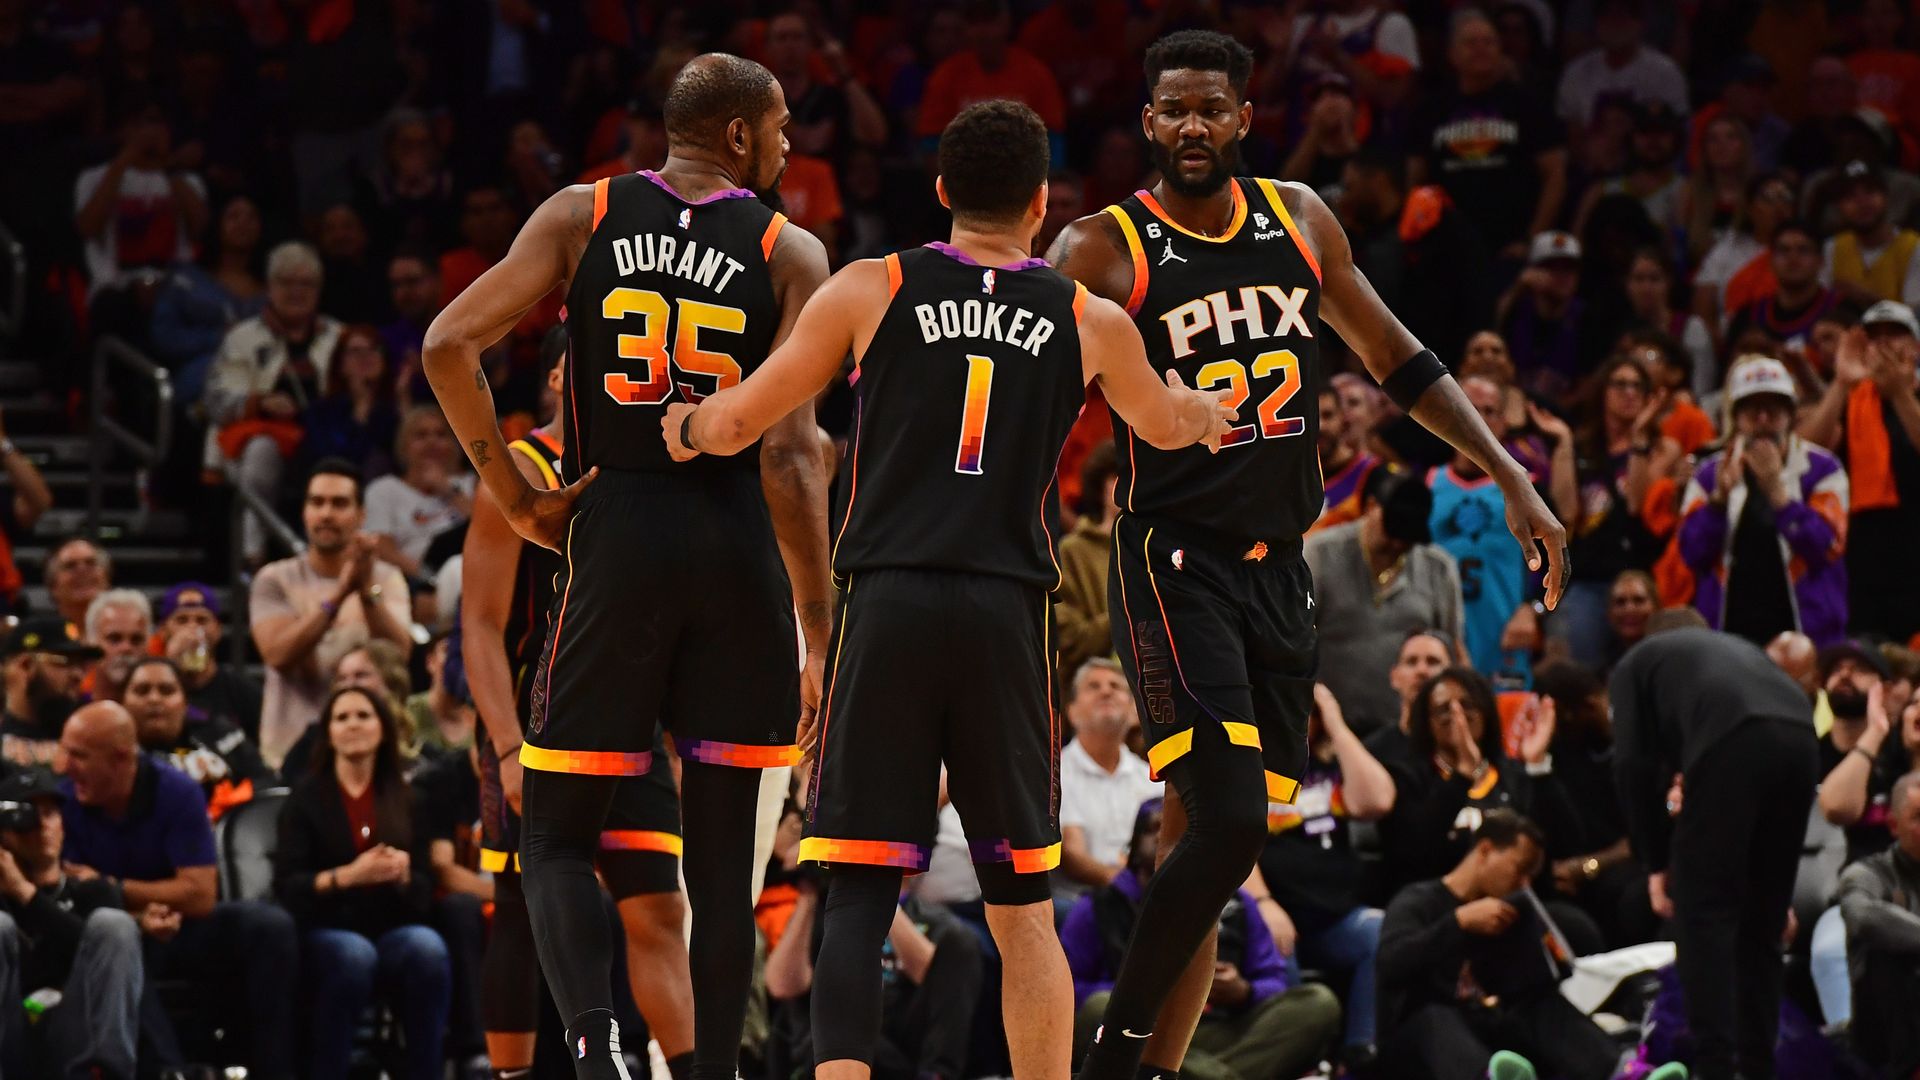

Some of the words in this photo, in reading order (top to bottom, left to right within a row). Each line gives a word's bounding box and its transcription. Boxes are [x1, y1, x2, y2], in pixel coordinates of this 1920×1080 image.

[611, 232, 746, 295] DURANT
[1145, 222, 1162, 239] 6
[1253, 229, 1285, 241] PayPal
[602, 286, 747, 406] 35
[914, 299, 1056, 357] BOOKER
[1158, 284, 1315, 360] PHX
[954, 353, 995, 476] 1
[1195, 348, 1306, 448] 22
